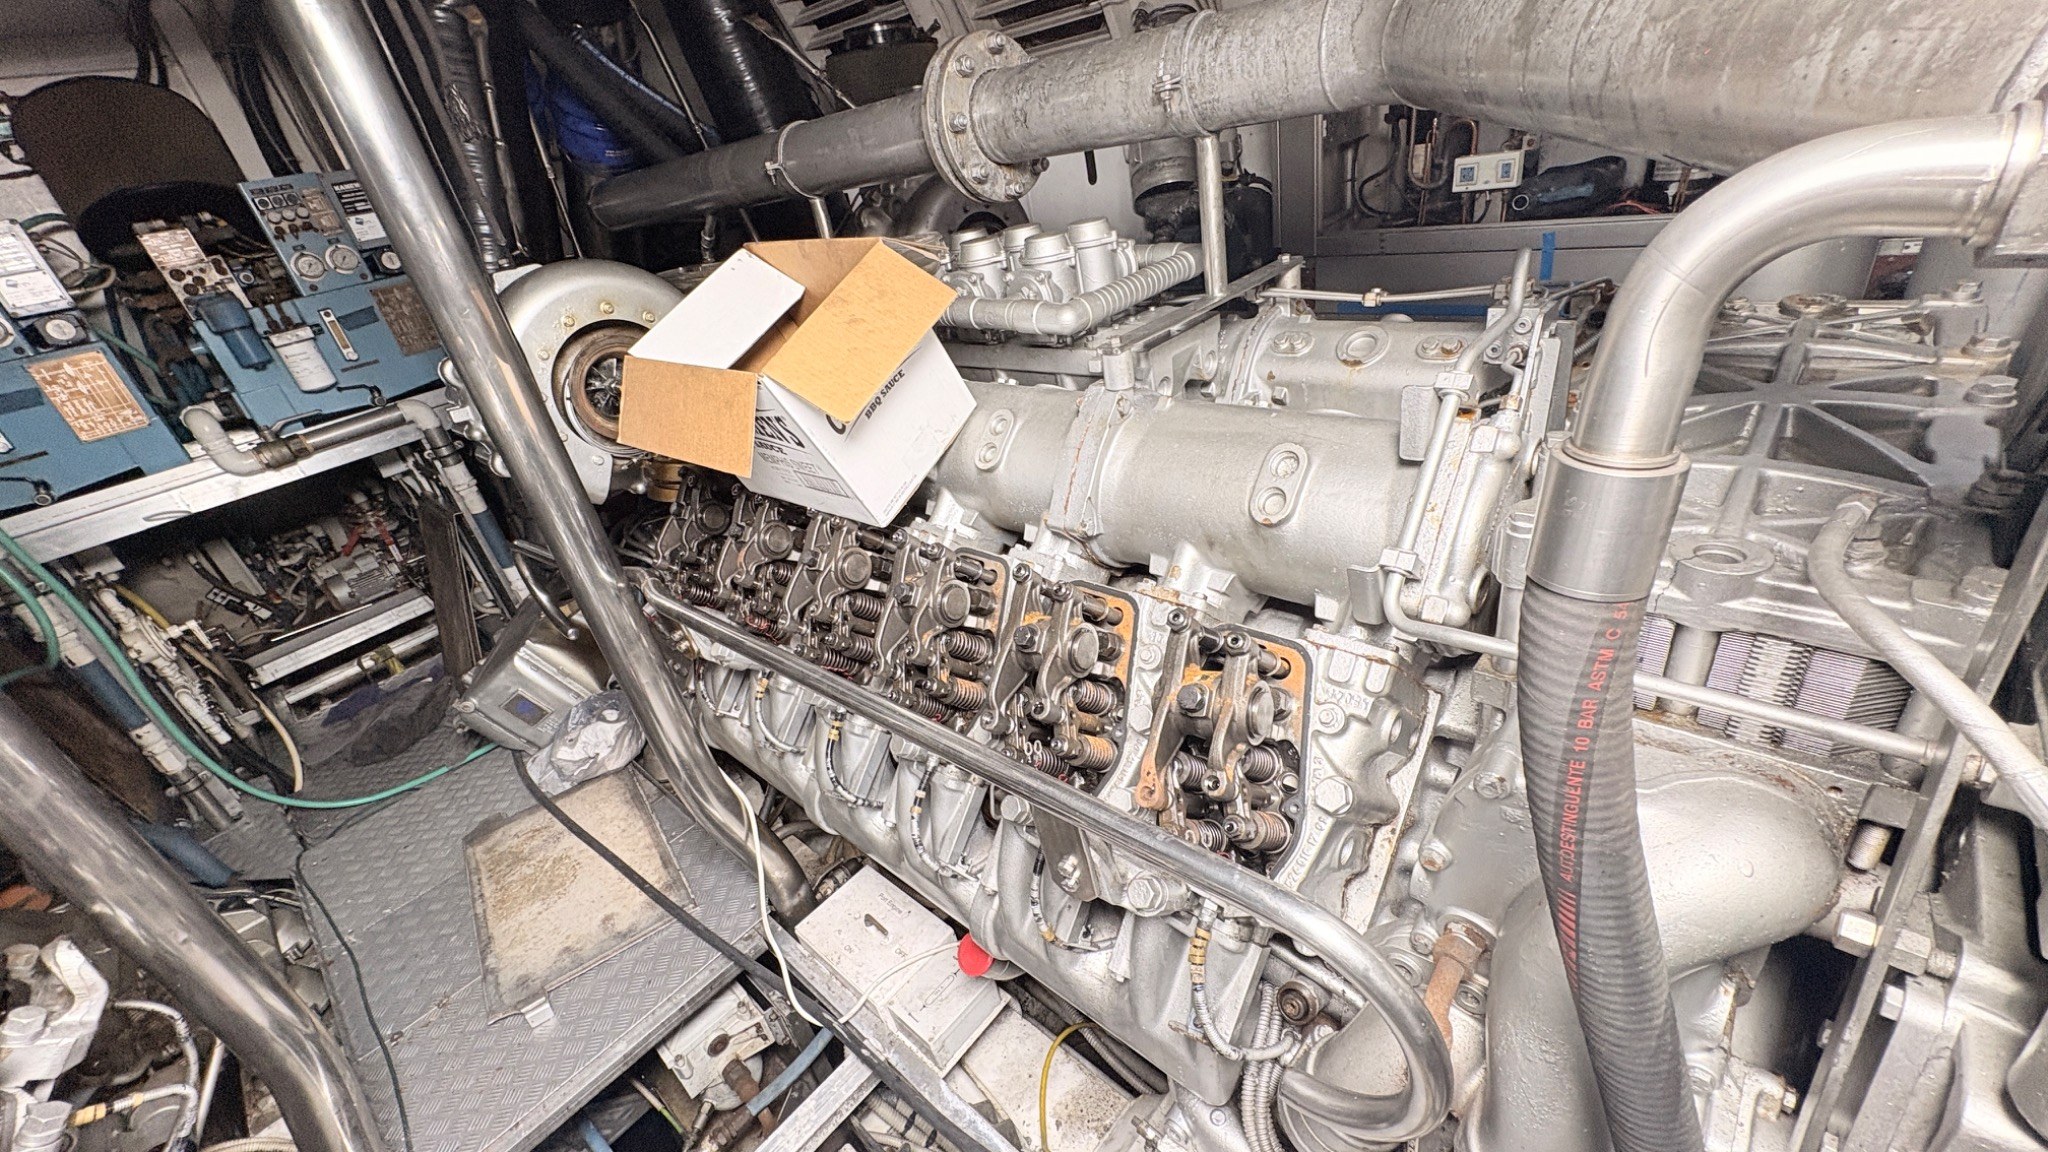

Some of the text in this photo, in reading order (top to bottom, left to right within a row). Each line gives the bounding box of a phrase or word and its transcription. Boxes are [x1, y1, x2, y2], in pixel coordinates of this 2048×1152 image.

[864, 369, 906, 420] BBQ SAUCE
[1605, 627, 1621, 640] C
[1587, 648, 1616, 692] ASTM
[1577, 699, 1598, 729] BAR
[1573, 736, 1591, 752] 10
[1560, 760, 1586, 883] AUTOESTINGUENTE
